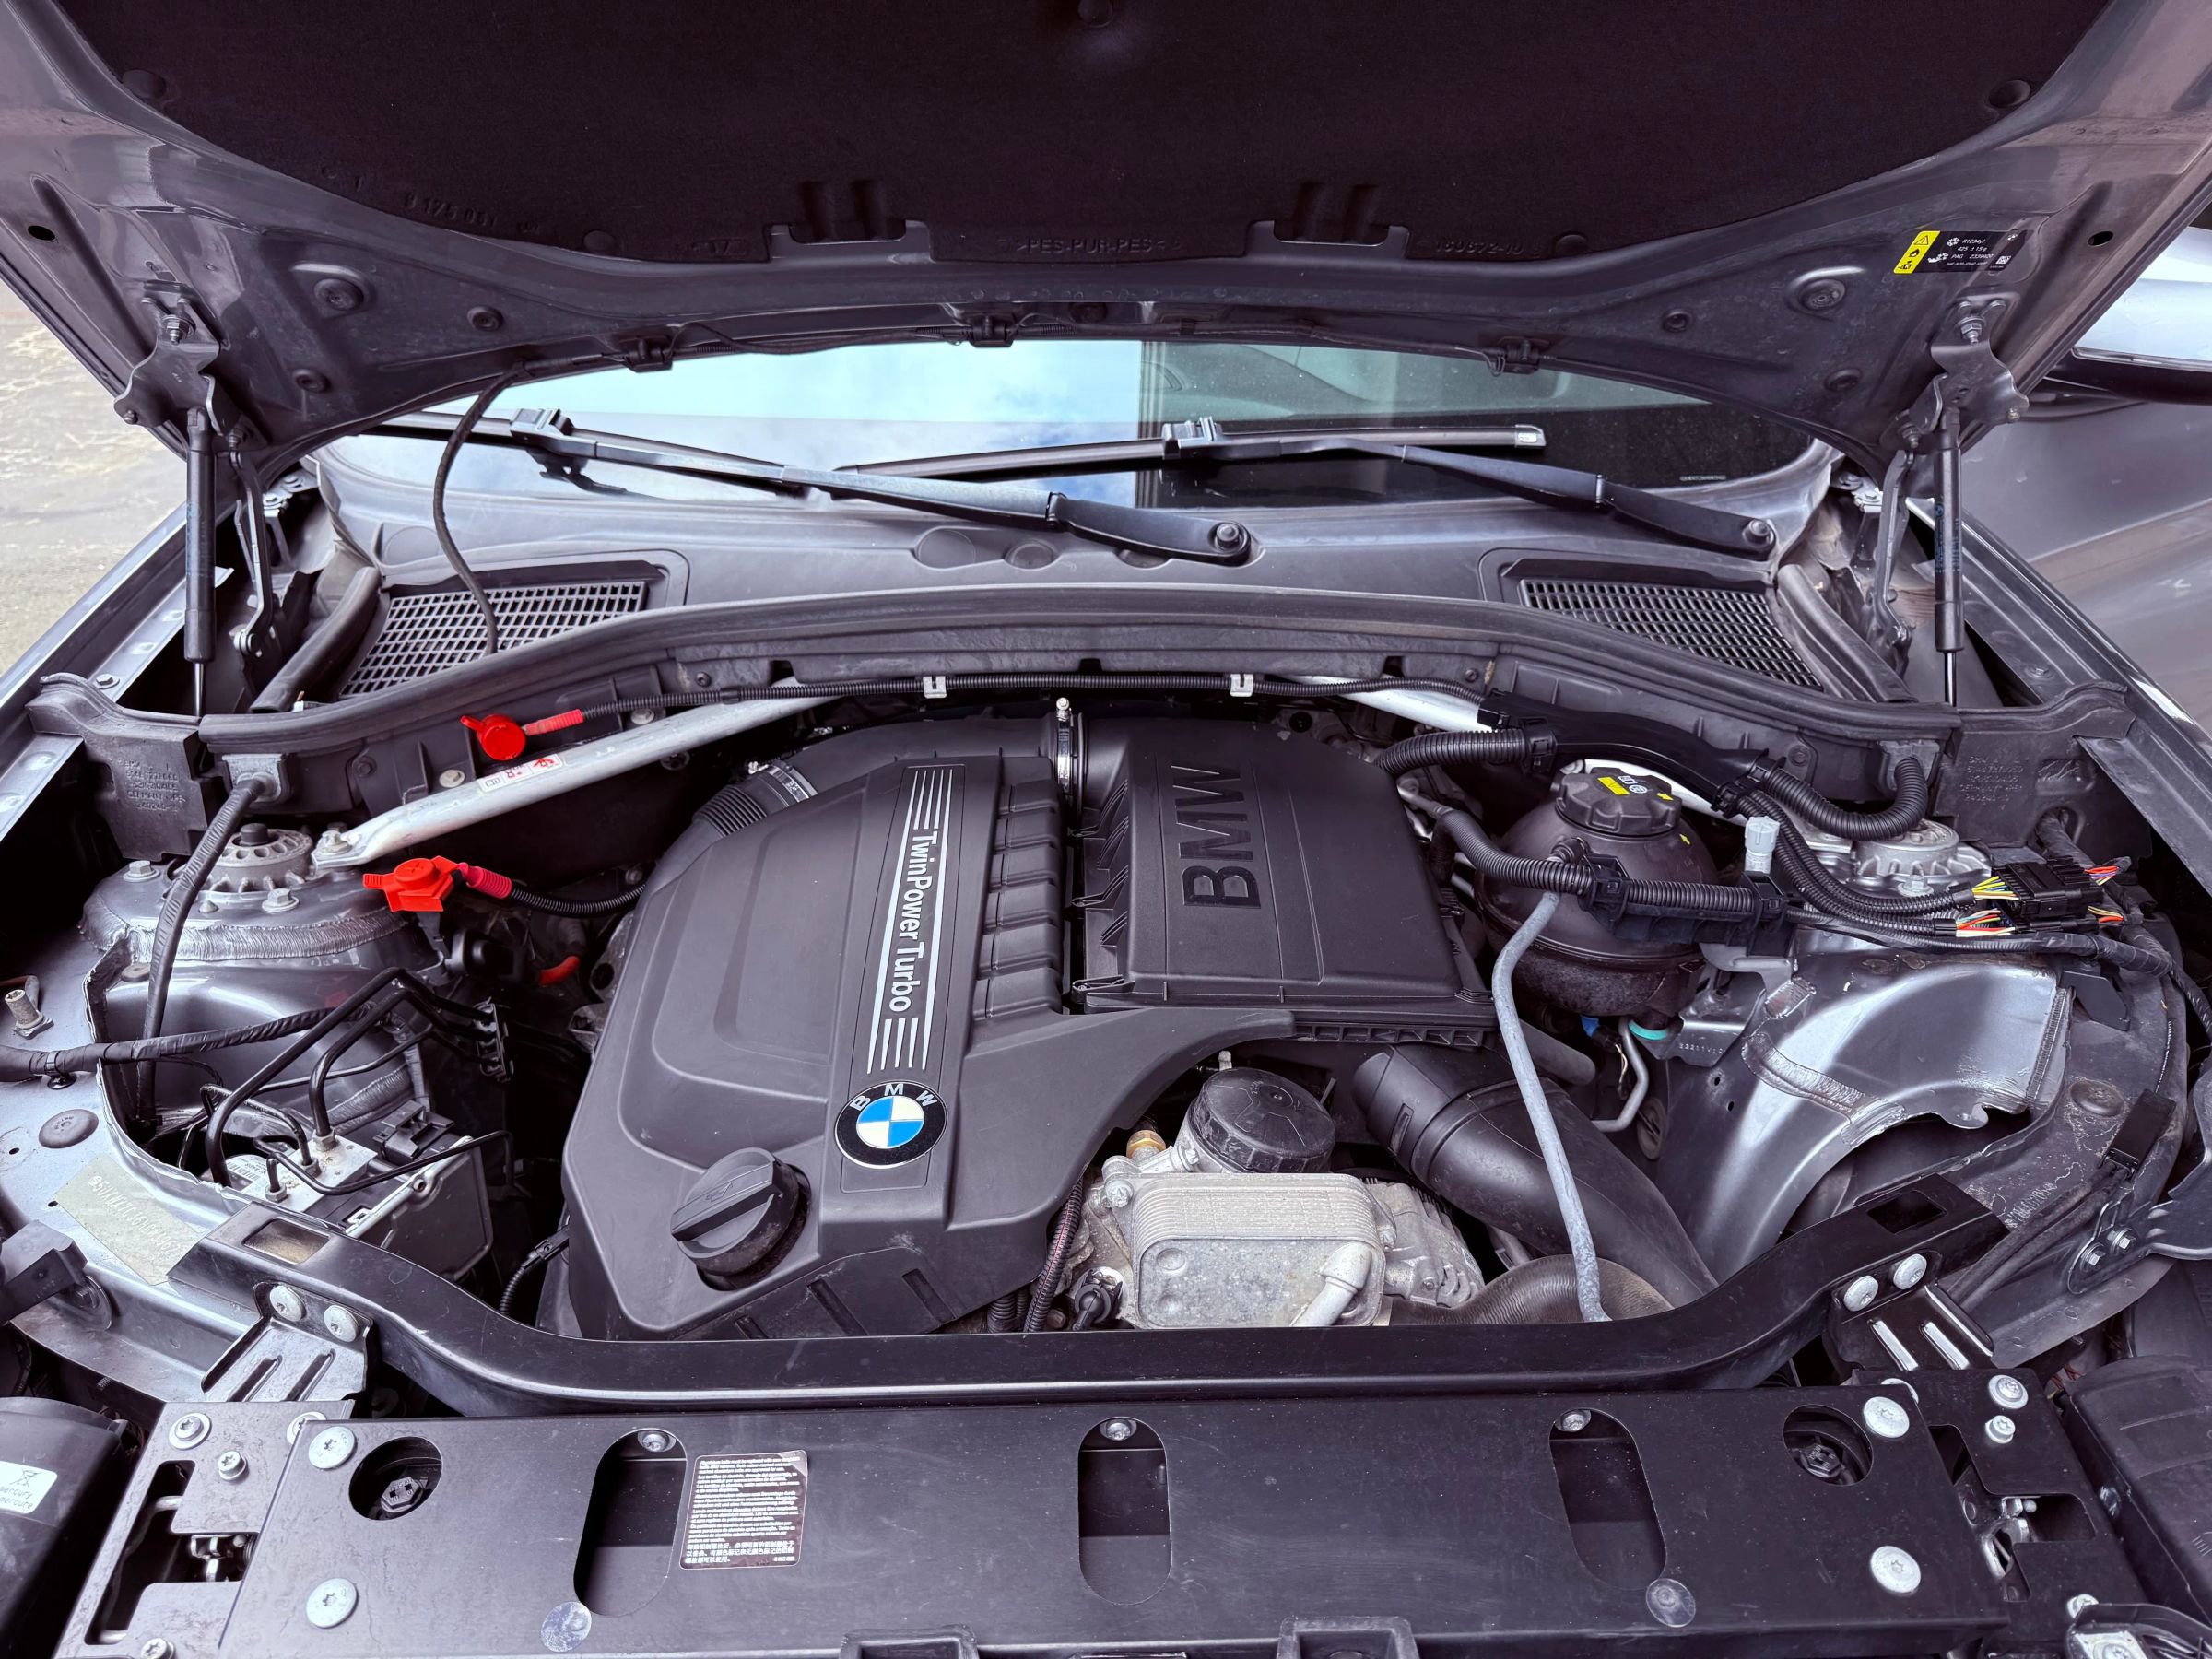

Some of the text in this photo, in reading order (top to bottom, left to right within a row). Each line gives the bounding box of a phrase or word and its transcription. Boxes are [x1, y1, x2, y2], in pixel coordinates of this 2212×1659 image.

[1170, 764, 1261, 909] BMW
[888, 830, 938, 1012] TwinPower Turbo
[849, 1083, 938, 1112] BMW
